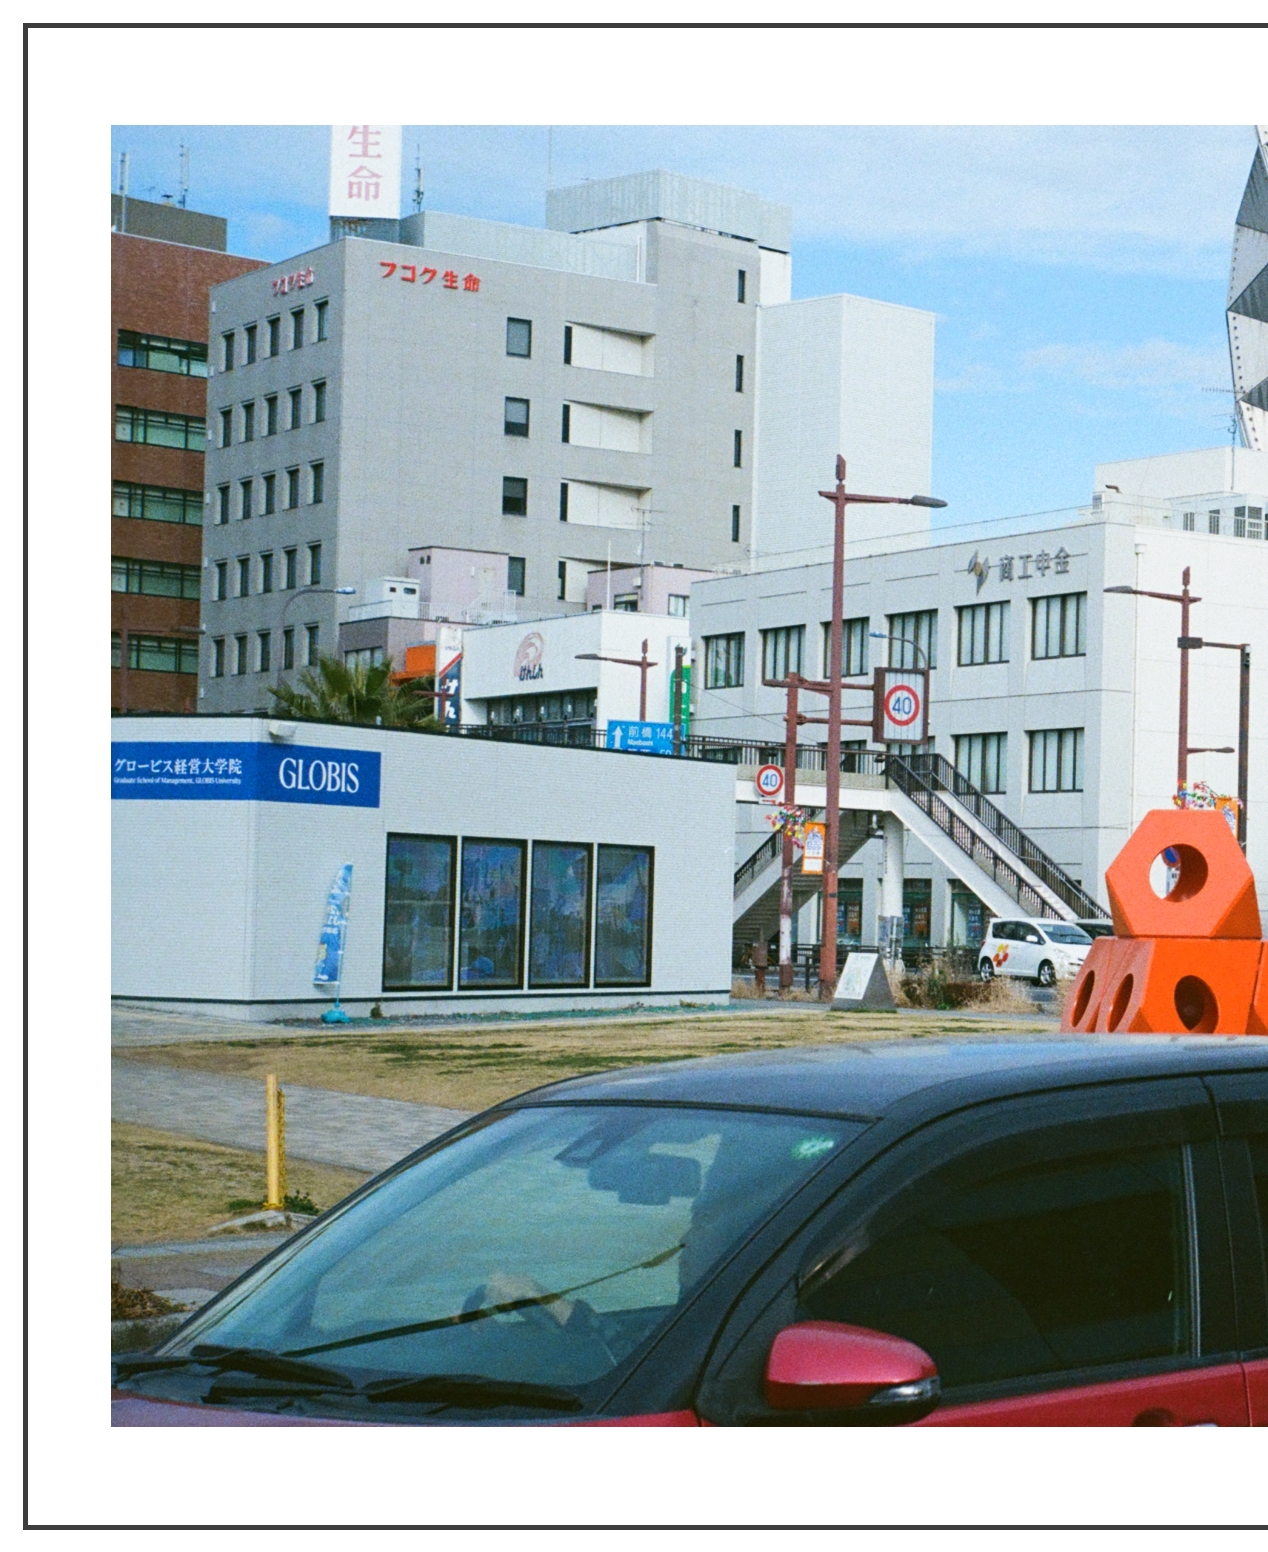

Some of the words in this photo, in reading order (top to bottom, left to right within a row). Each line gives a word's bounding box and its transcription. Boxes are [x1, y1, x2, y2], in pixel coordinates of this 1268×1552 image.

[347, 125, 383, 201] 生命
[380, 261, 481, 292] フコク生命
[1000, 547, 1070, 582] 商工中金
[519, 663, 544, 681] けんしん
[892, 696, 913, 716] 40
[656, 727, 673, 740] 144
[113, 758, 243, 775] グロービス経営大学院
[279, 757, 360, 793] GLOBIS
[762, 773, 778, 788] 40
